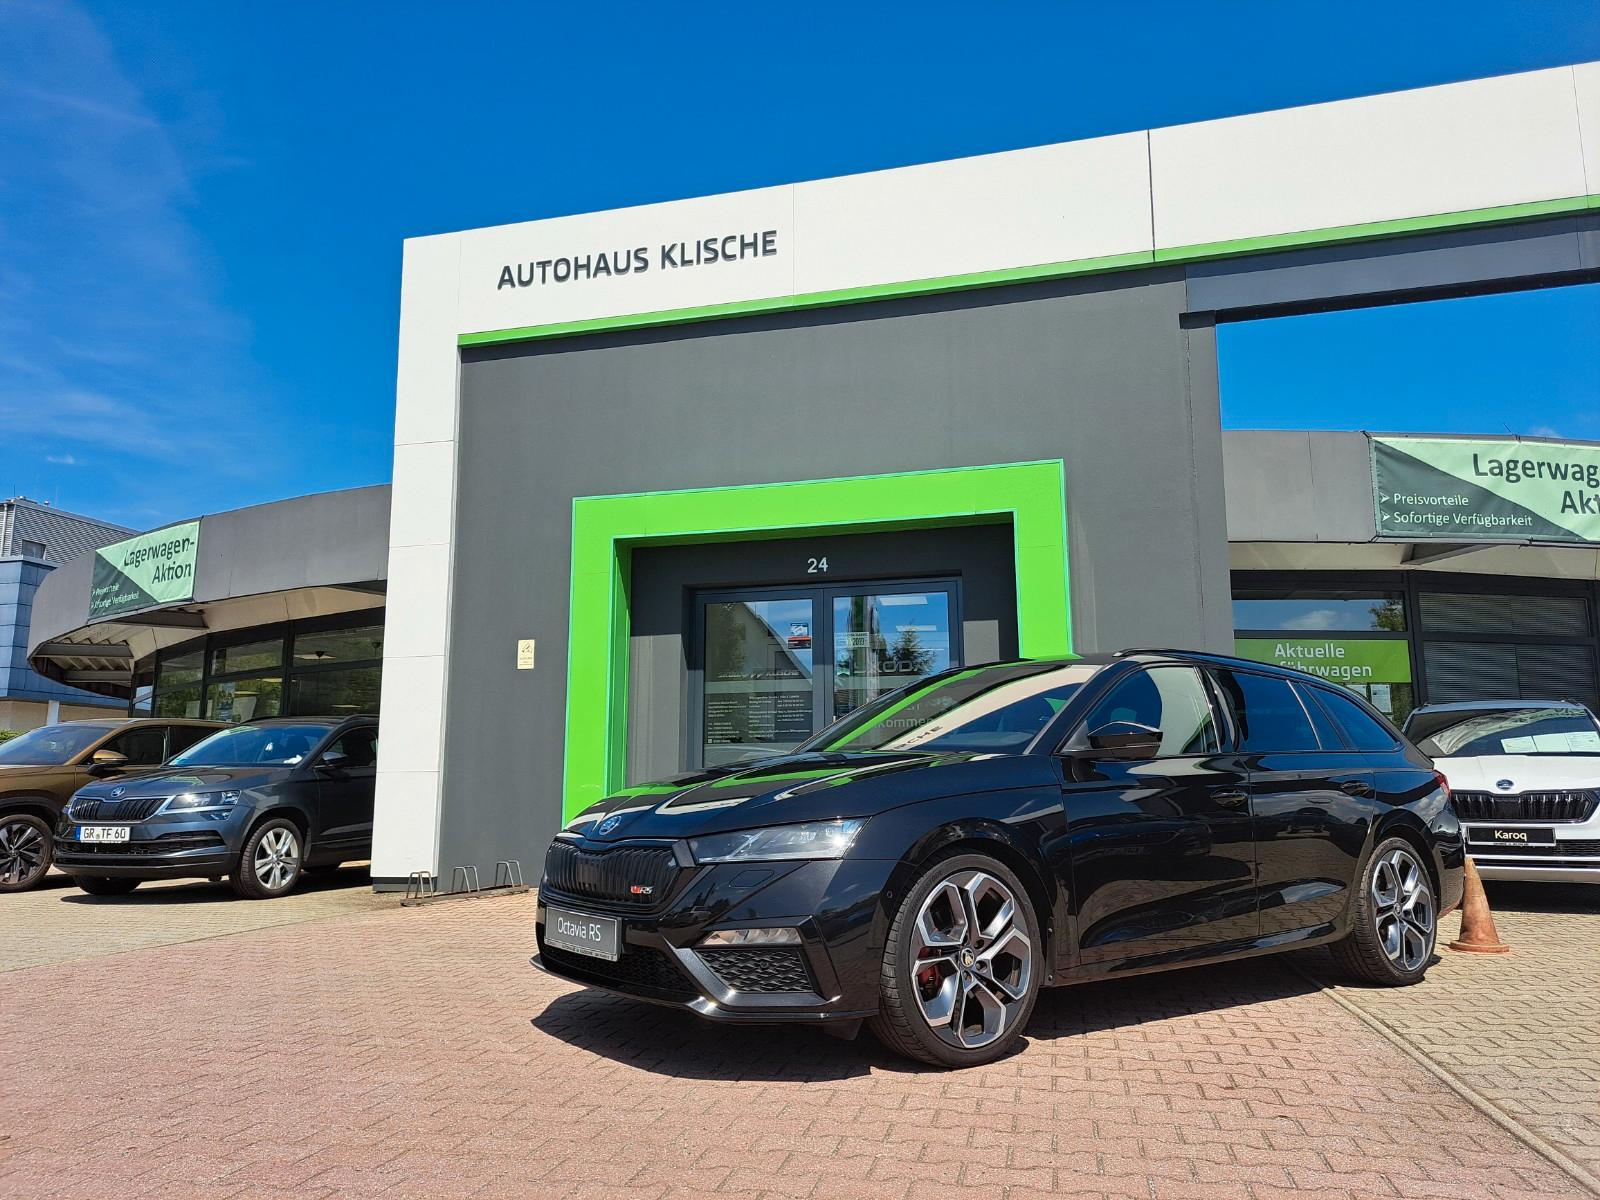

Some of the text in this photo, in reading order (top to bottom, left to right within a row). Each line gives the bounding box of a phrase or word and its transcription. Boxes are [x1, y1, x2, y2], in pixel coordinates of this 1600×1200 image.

[497, 230, 777, 290] AUTOHAUS KLISCHE
[1393, 493, 1469, 506] Preisvorteile
[1393, 511, 1533, 528] Sofortige Verfügbarkeit
[152, 561, 192, 584] Aktion
[807, 557, 829, 573] 24
[1274, 643, 1345, 658] Aktuelle
[83, 828, 126, 839] GR TF 60
[1494, 830, 1528, 842] Karoq
[557, 917, 602, 942] Octavia RS
